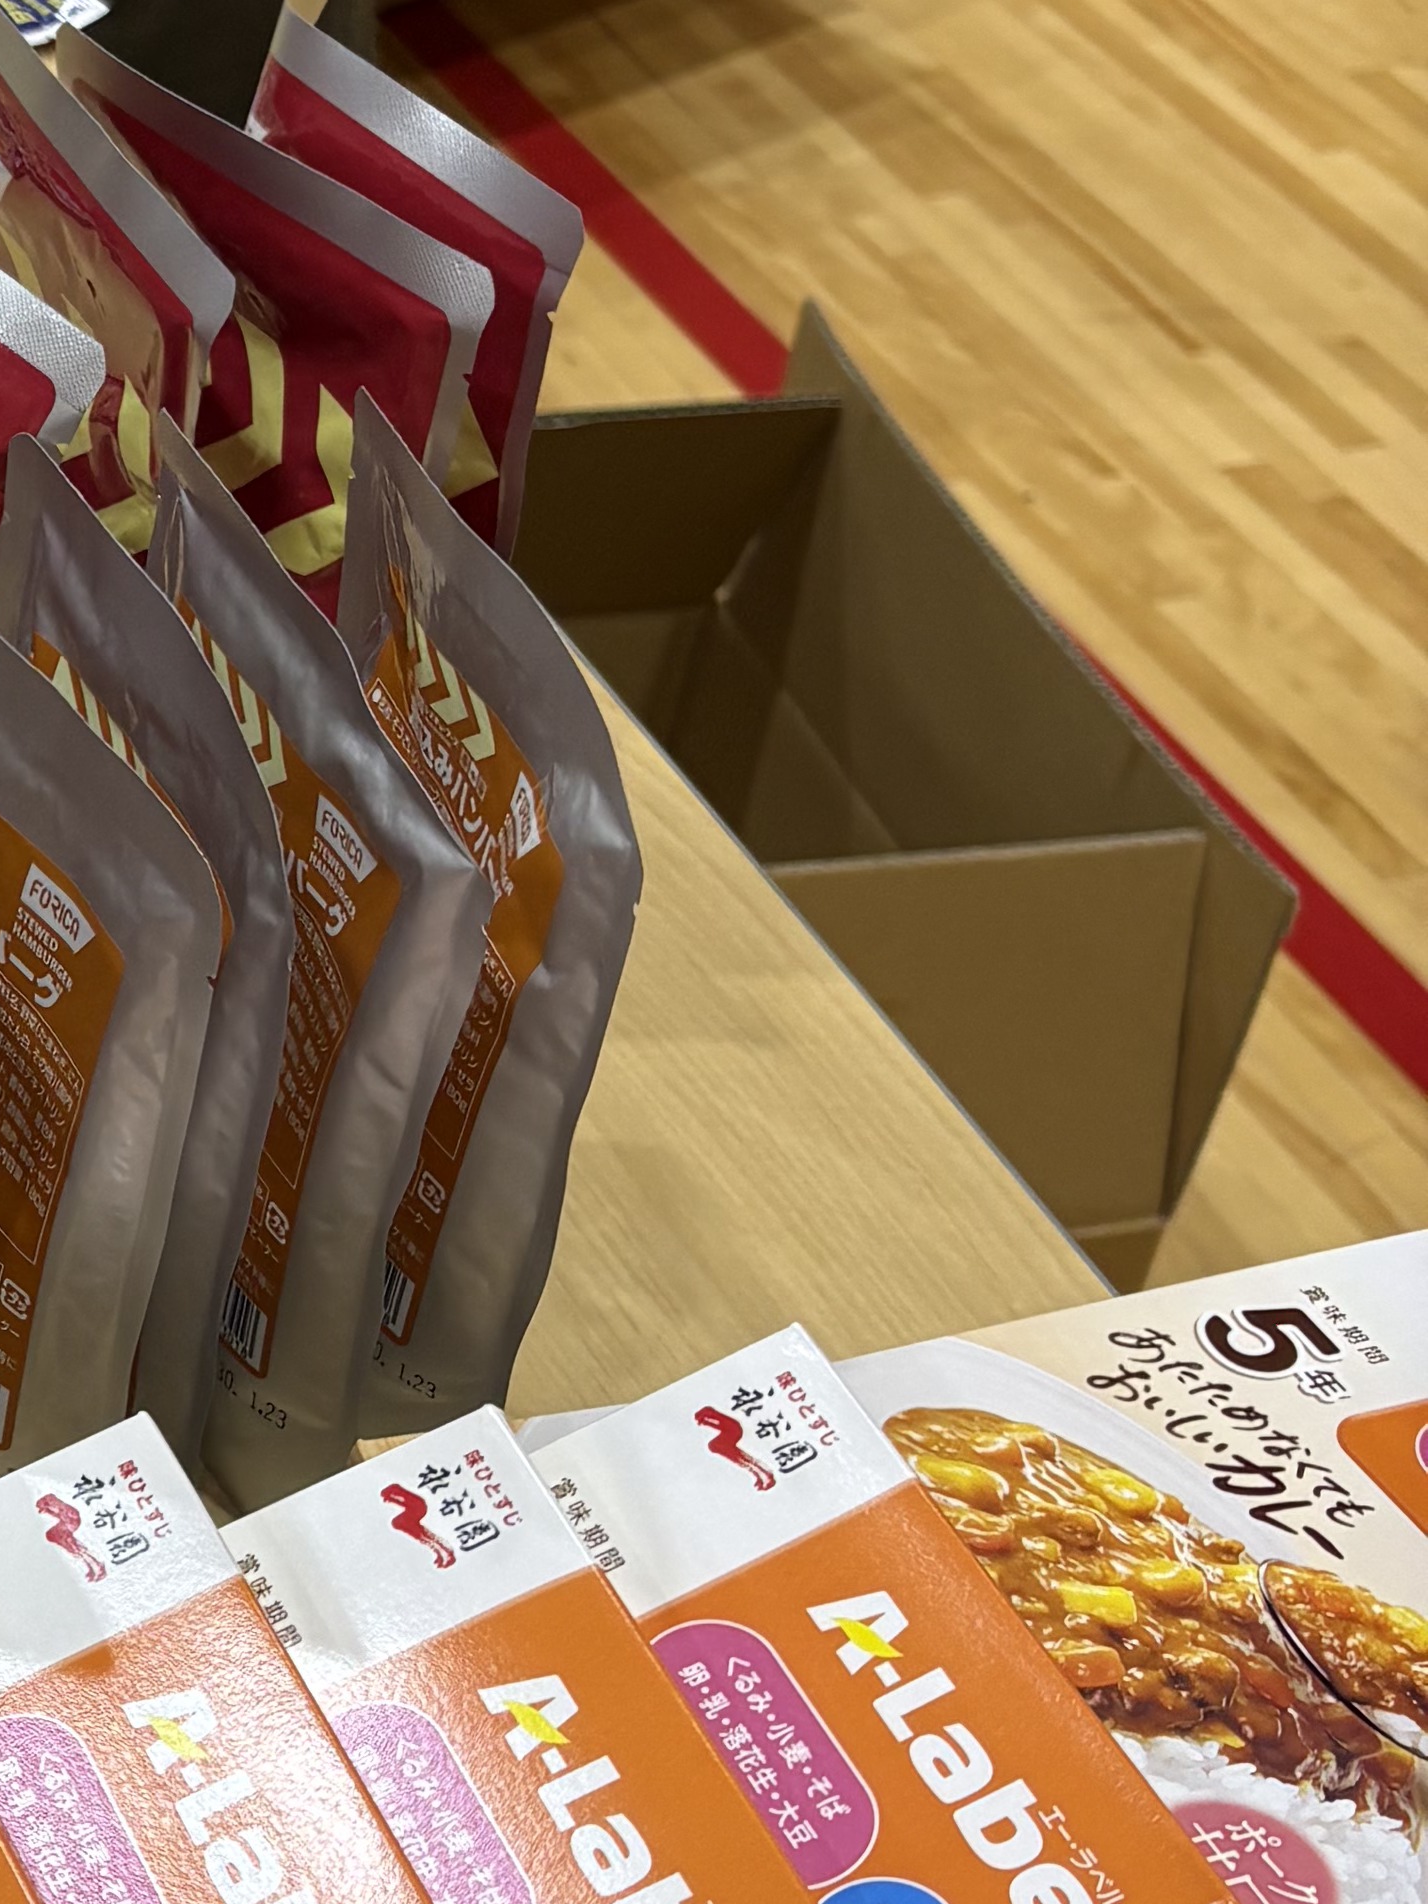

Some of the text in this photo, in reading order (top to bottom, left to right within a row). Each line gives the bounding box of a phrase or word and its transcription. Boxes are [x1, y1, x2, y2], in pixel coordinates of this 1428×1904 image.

[321, 811, 362, 870] FORICA
[28, 880, 79, 940] FORICA
[1300, 1286, 1390, 1367] 賞味期間
[550, 1477, 625, 1573] 賞味期間
[723, 1656, 850, 1822] くるみ・小麦・そば
